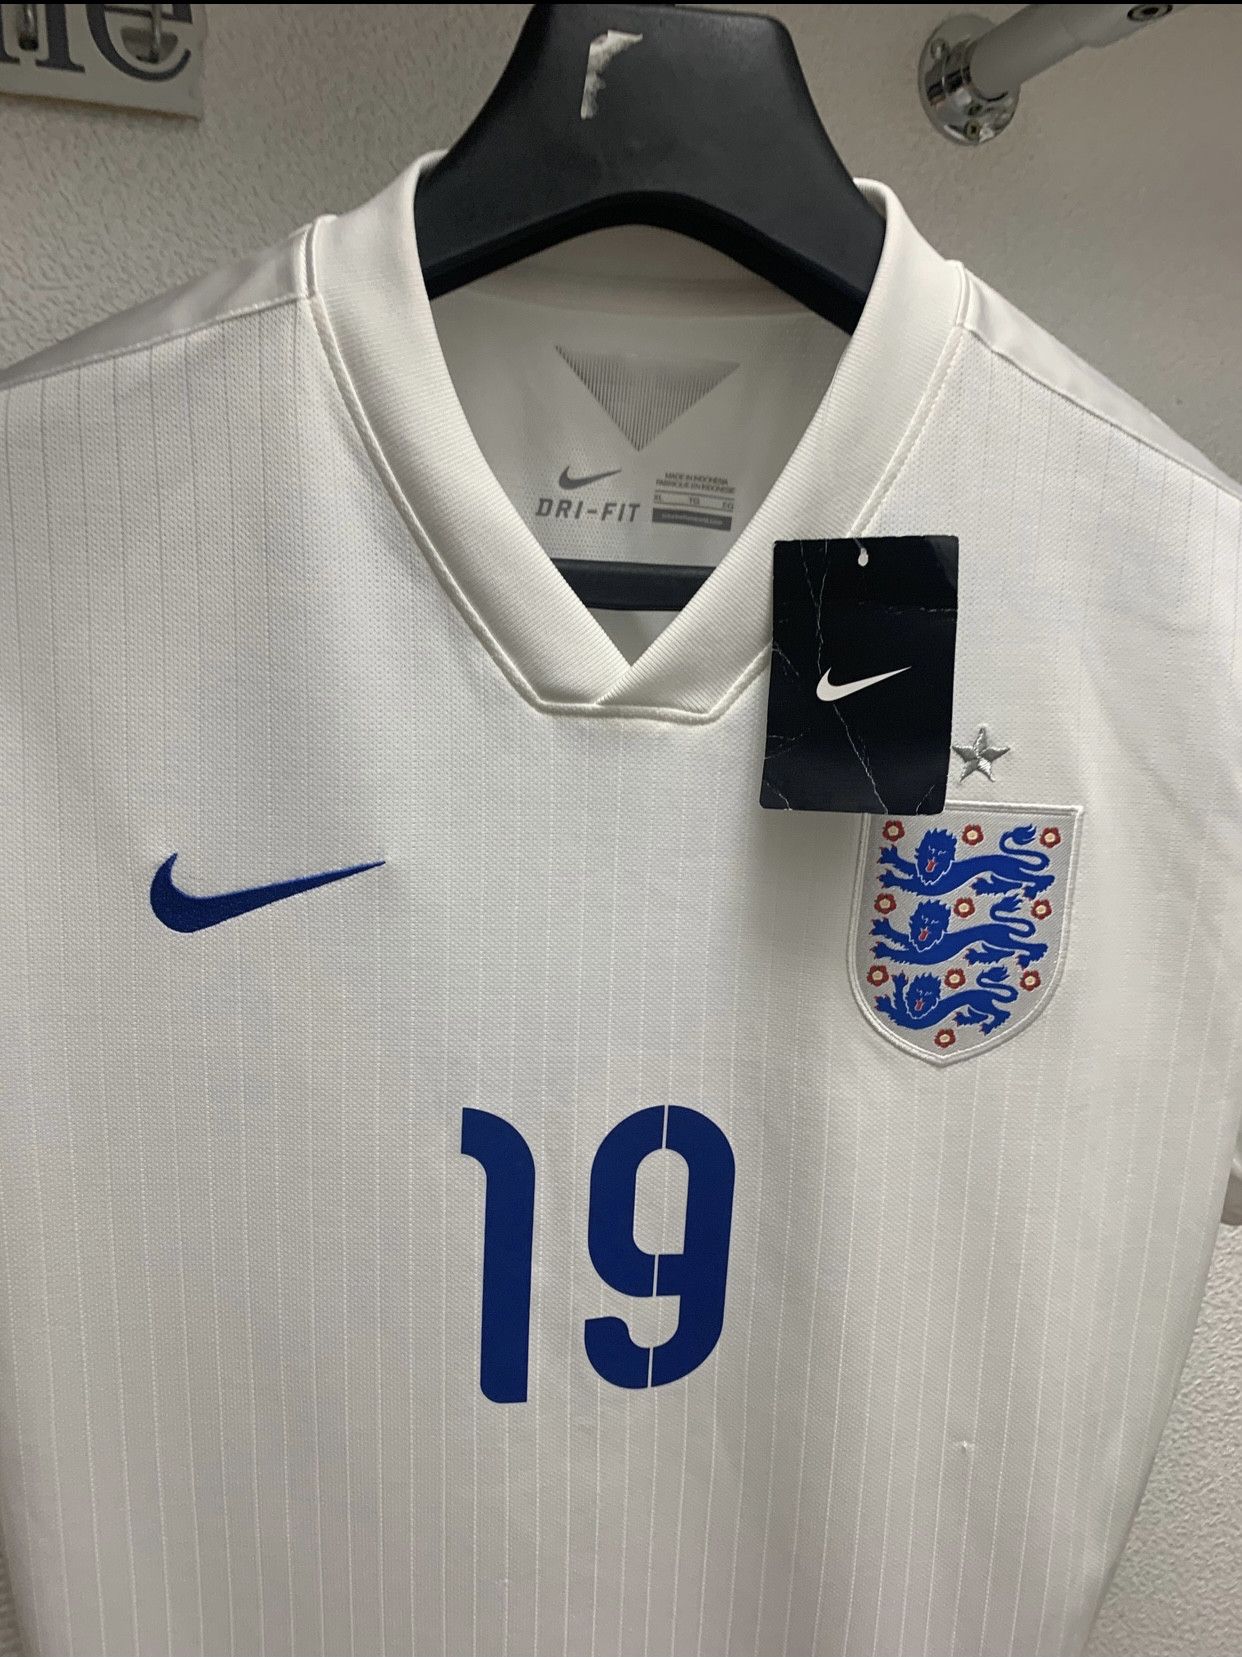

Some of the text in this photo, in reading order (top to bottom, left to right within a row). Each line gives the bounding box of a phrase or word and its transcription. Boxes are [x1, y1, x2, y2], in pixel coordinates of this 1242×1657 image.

[664, 472, 684, 480] MADE
[535, 498, 640, 522] DRI-FIT
[461, 1105, 735, 1404] 19
